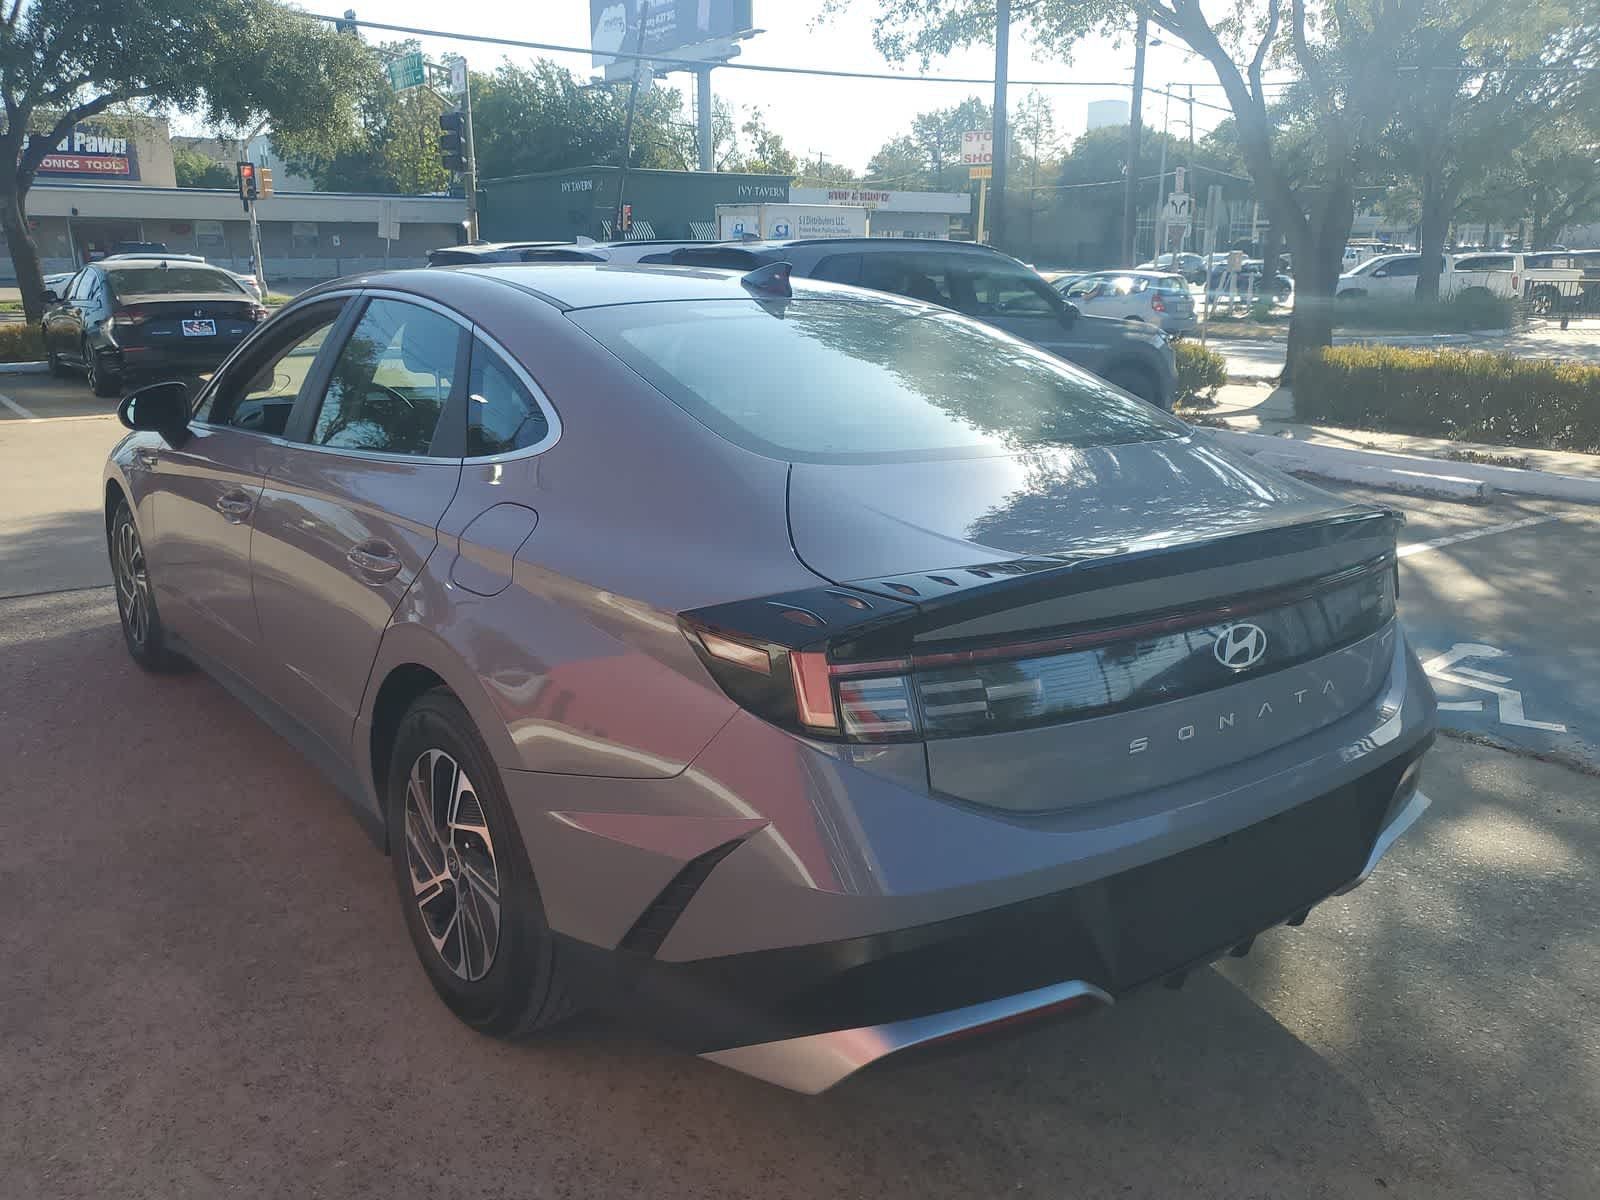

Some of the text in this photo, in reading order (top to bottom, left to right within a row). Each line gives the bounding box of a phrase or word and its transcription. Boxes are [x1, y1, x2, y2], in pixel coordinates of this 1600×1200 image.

[965, 132, 992, 142] STO
[74, 132, 127, 154] Pawn
[964, 152, 992, 163] SHO
[86, 160, 124, 170] TOOLS
[738, 185, 785, 197] IVY TAVERN
[1129, 679, 1335, 754] SONATA
